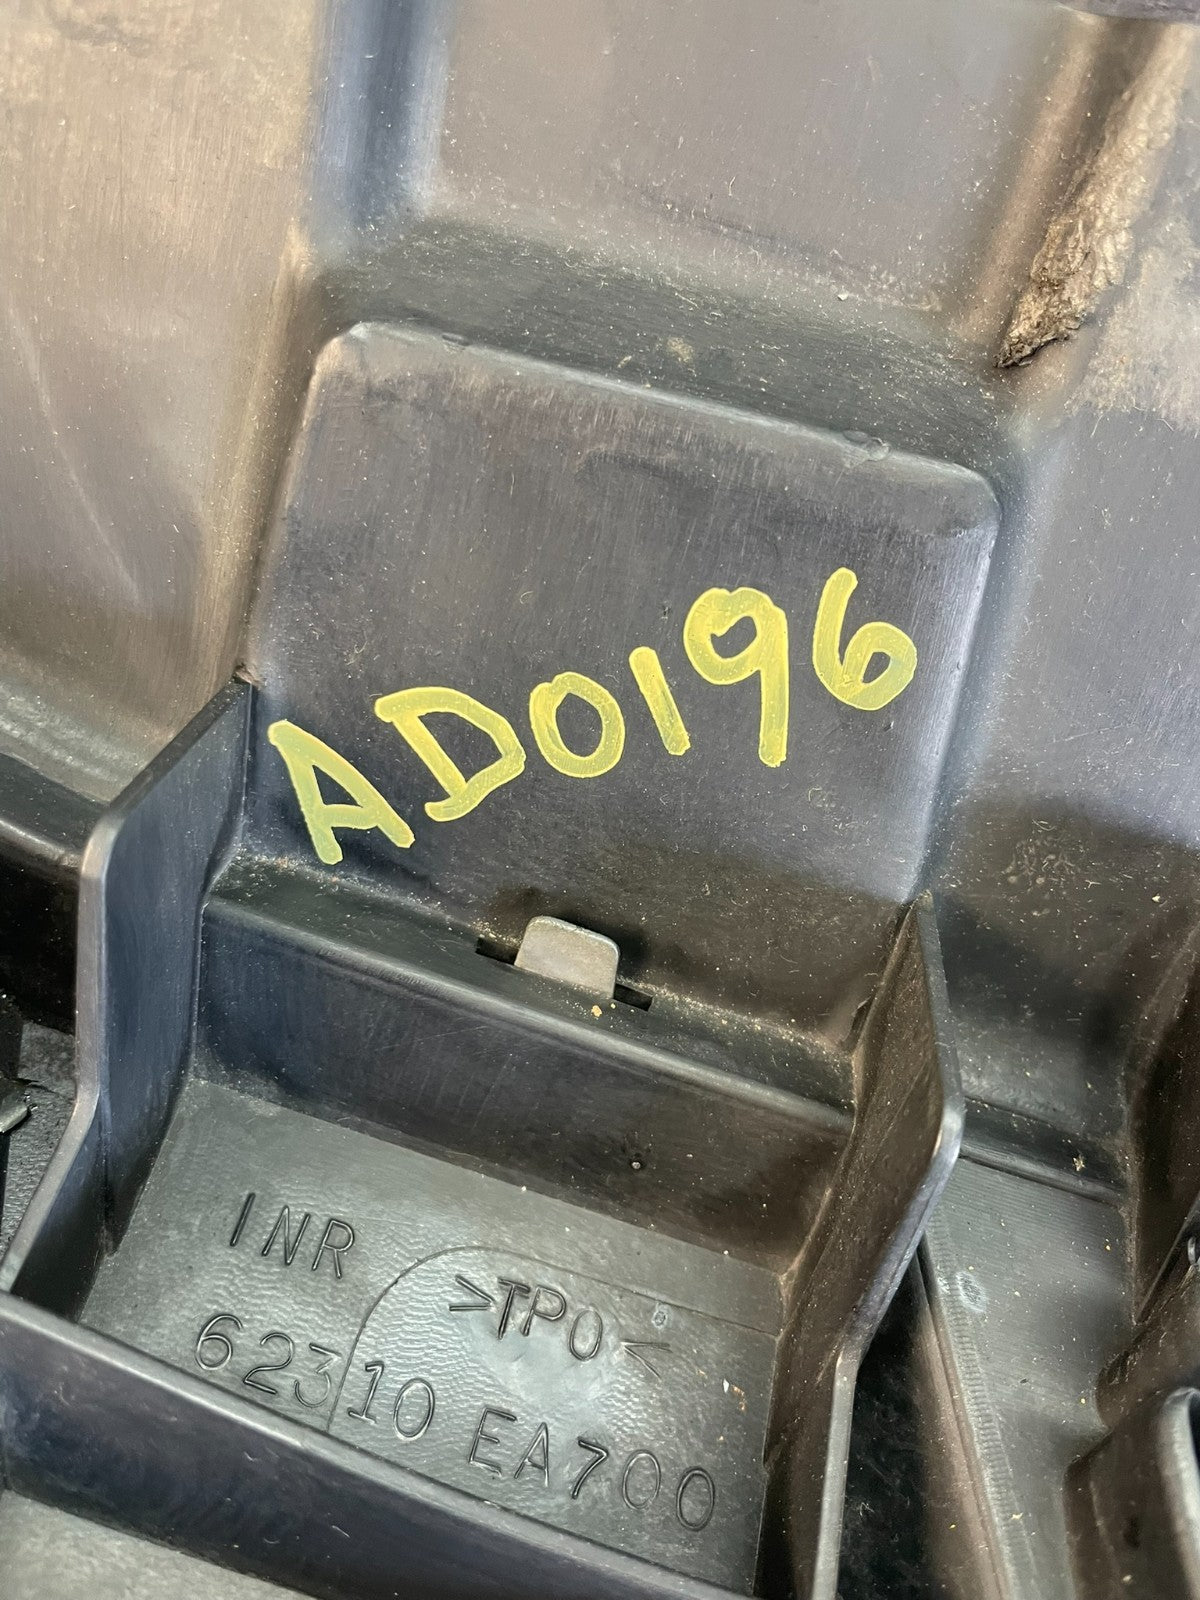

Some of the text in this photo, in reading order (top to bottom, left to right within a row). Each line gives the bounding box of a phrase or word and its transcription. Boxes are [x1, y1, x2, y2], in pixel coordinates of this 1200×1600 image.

[229, 1191, 356, 1280] INR
[194, 1312, 716, 1532] 62310 EA700
